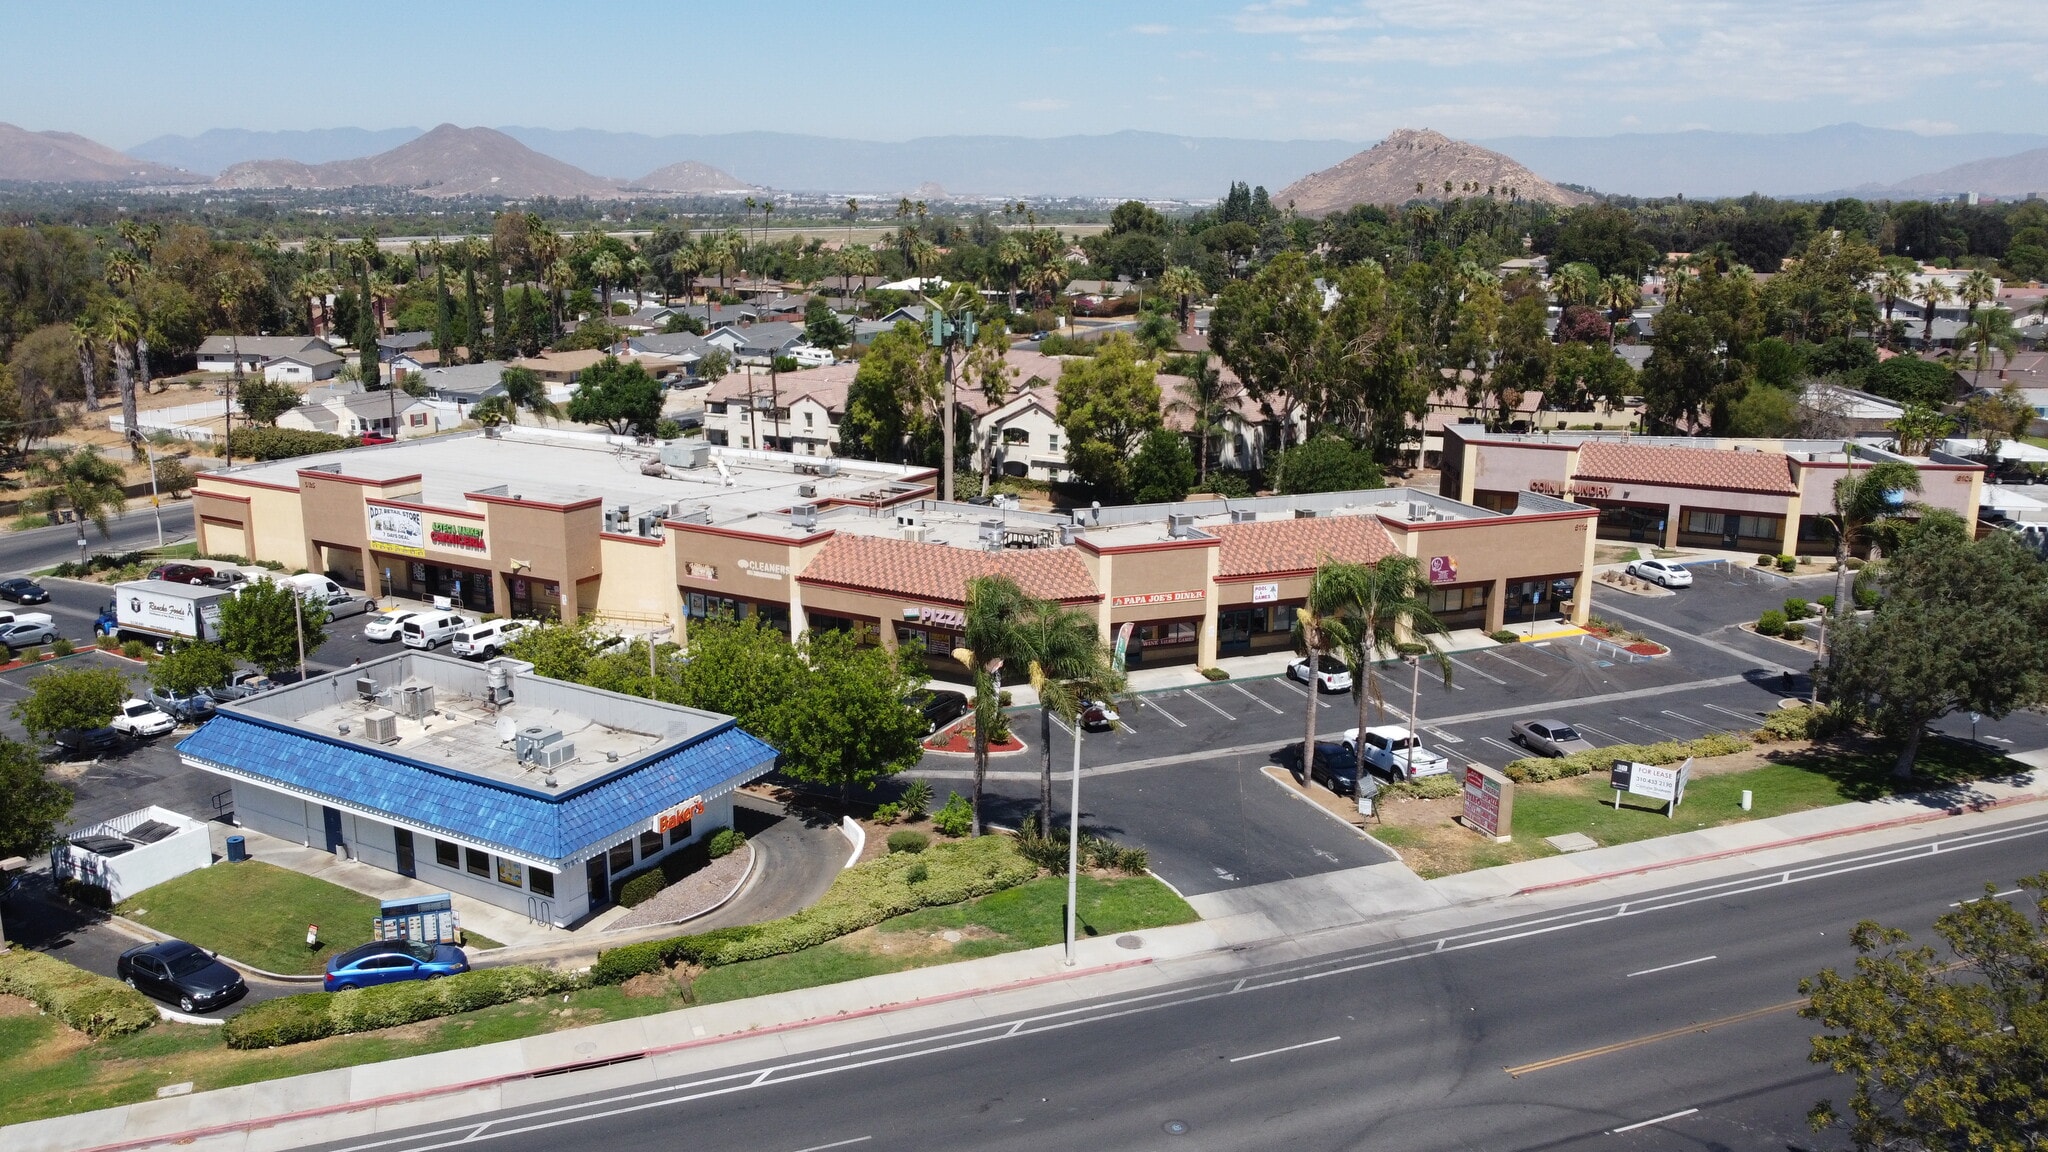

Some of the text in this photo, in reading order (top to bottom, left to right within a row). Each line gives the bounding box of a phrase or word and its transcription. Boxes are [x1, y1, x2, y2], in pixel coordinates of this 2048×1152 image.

[1530, 481, 1611, 498] COIN LAUNDRY
[402, 511, 420, 525] STORE
[432, 521, 483, 538] AZTECA MARKET
[431, 531, 487, 550] CARNICERIA
[749, 560, 791, 575] CLEANERS
[1123, 591, 1203, 605] PAPA JOE'S DINER
[149, 602, 168, 613] Rancho
[168, 605, 185, 616] Foods
[921, 607, 967, 626] PIZZA
[1639, 767, 1651, 775] FOR
[1653, 770, 1672, 779] LEASE
[659, 800, 704, 834] Baker's
